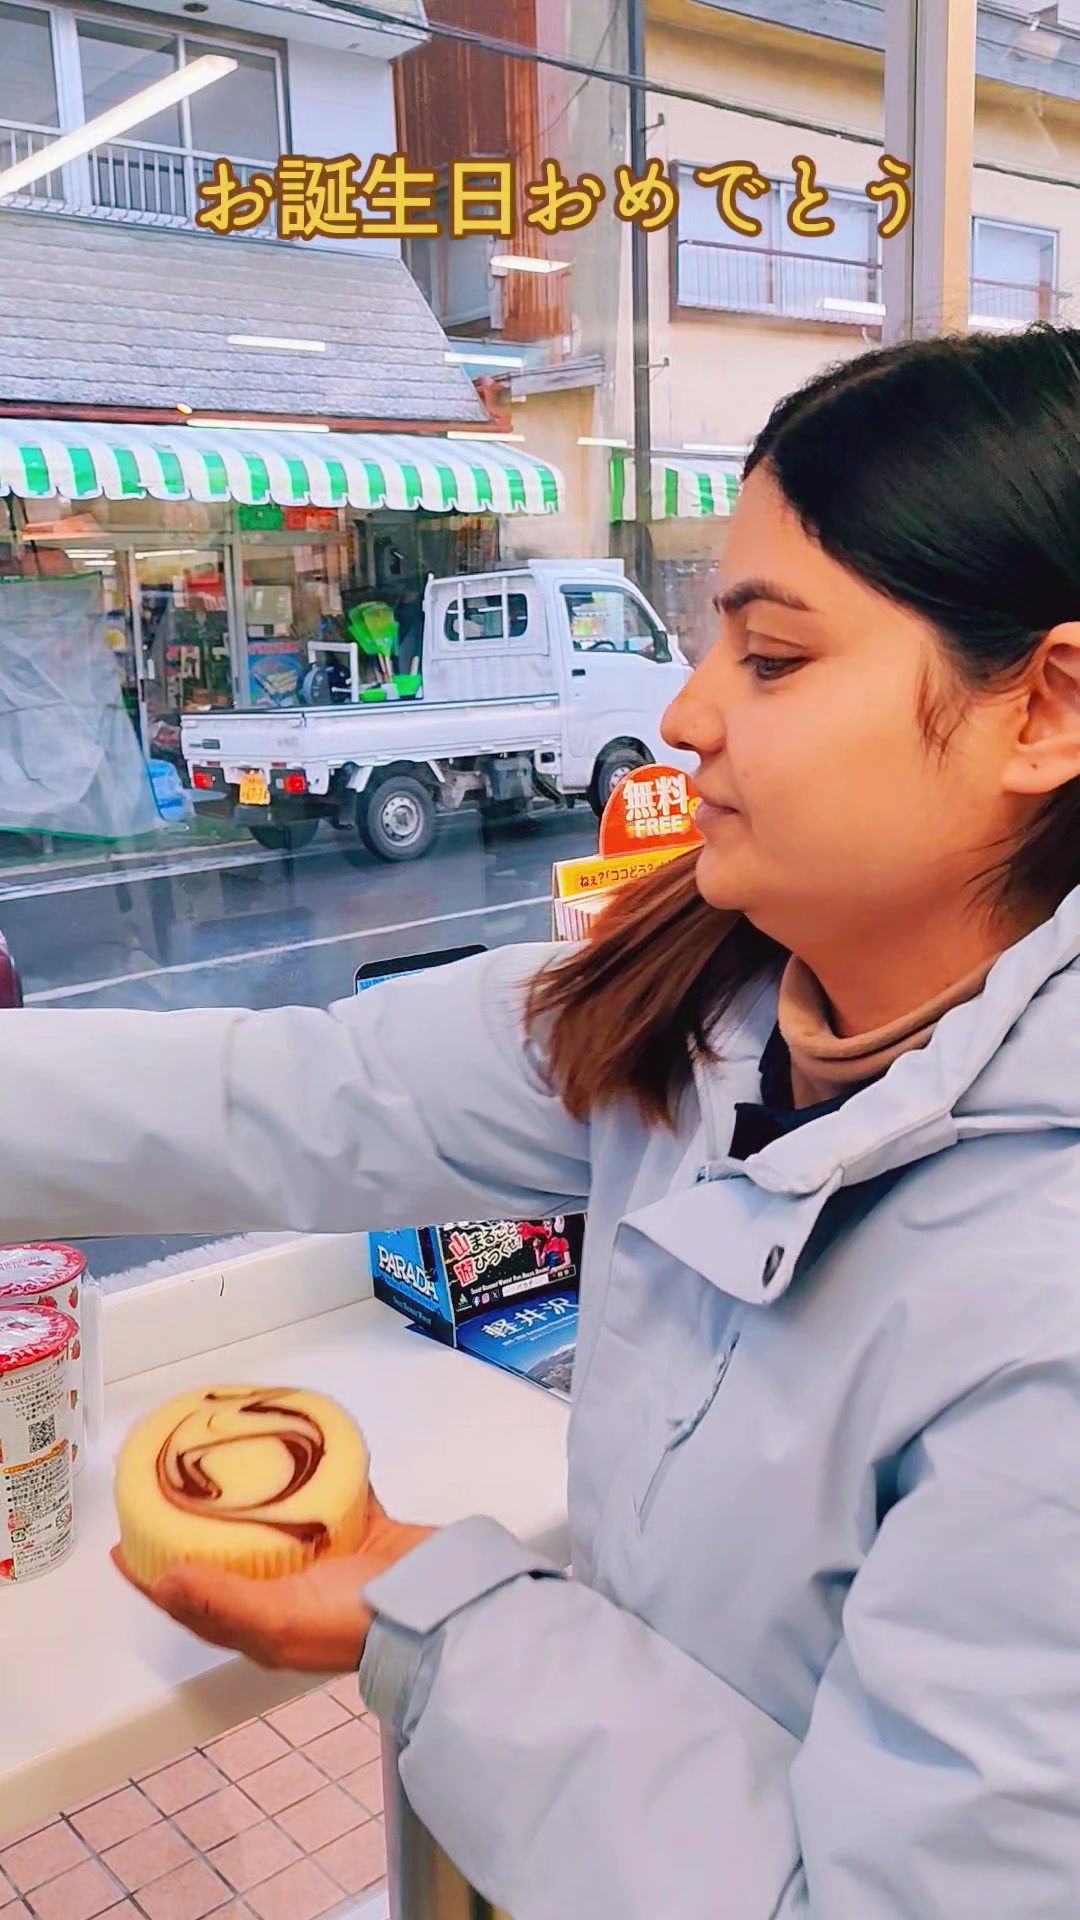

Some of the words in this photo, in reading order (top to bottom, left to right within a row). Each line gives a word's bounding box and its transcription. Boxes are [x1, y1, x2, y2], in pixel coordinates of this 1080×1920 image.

[623, 774, 690, 820] 無料
[634, 815, 685, 838] FREE
[450, 1222, 517, 1259] 山まるごと
[481, 1298, 579, 1338] 軽井沢
